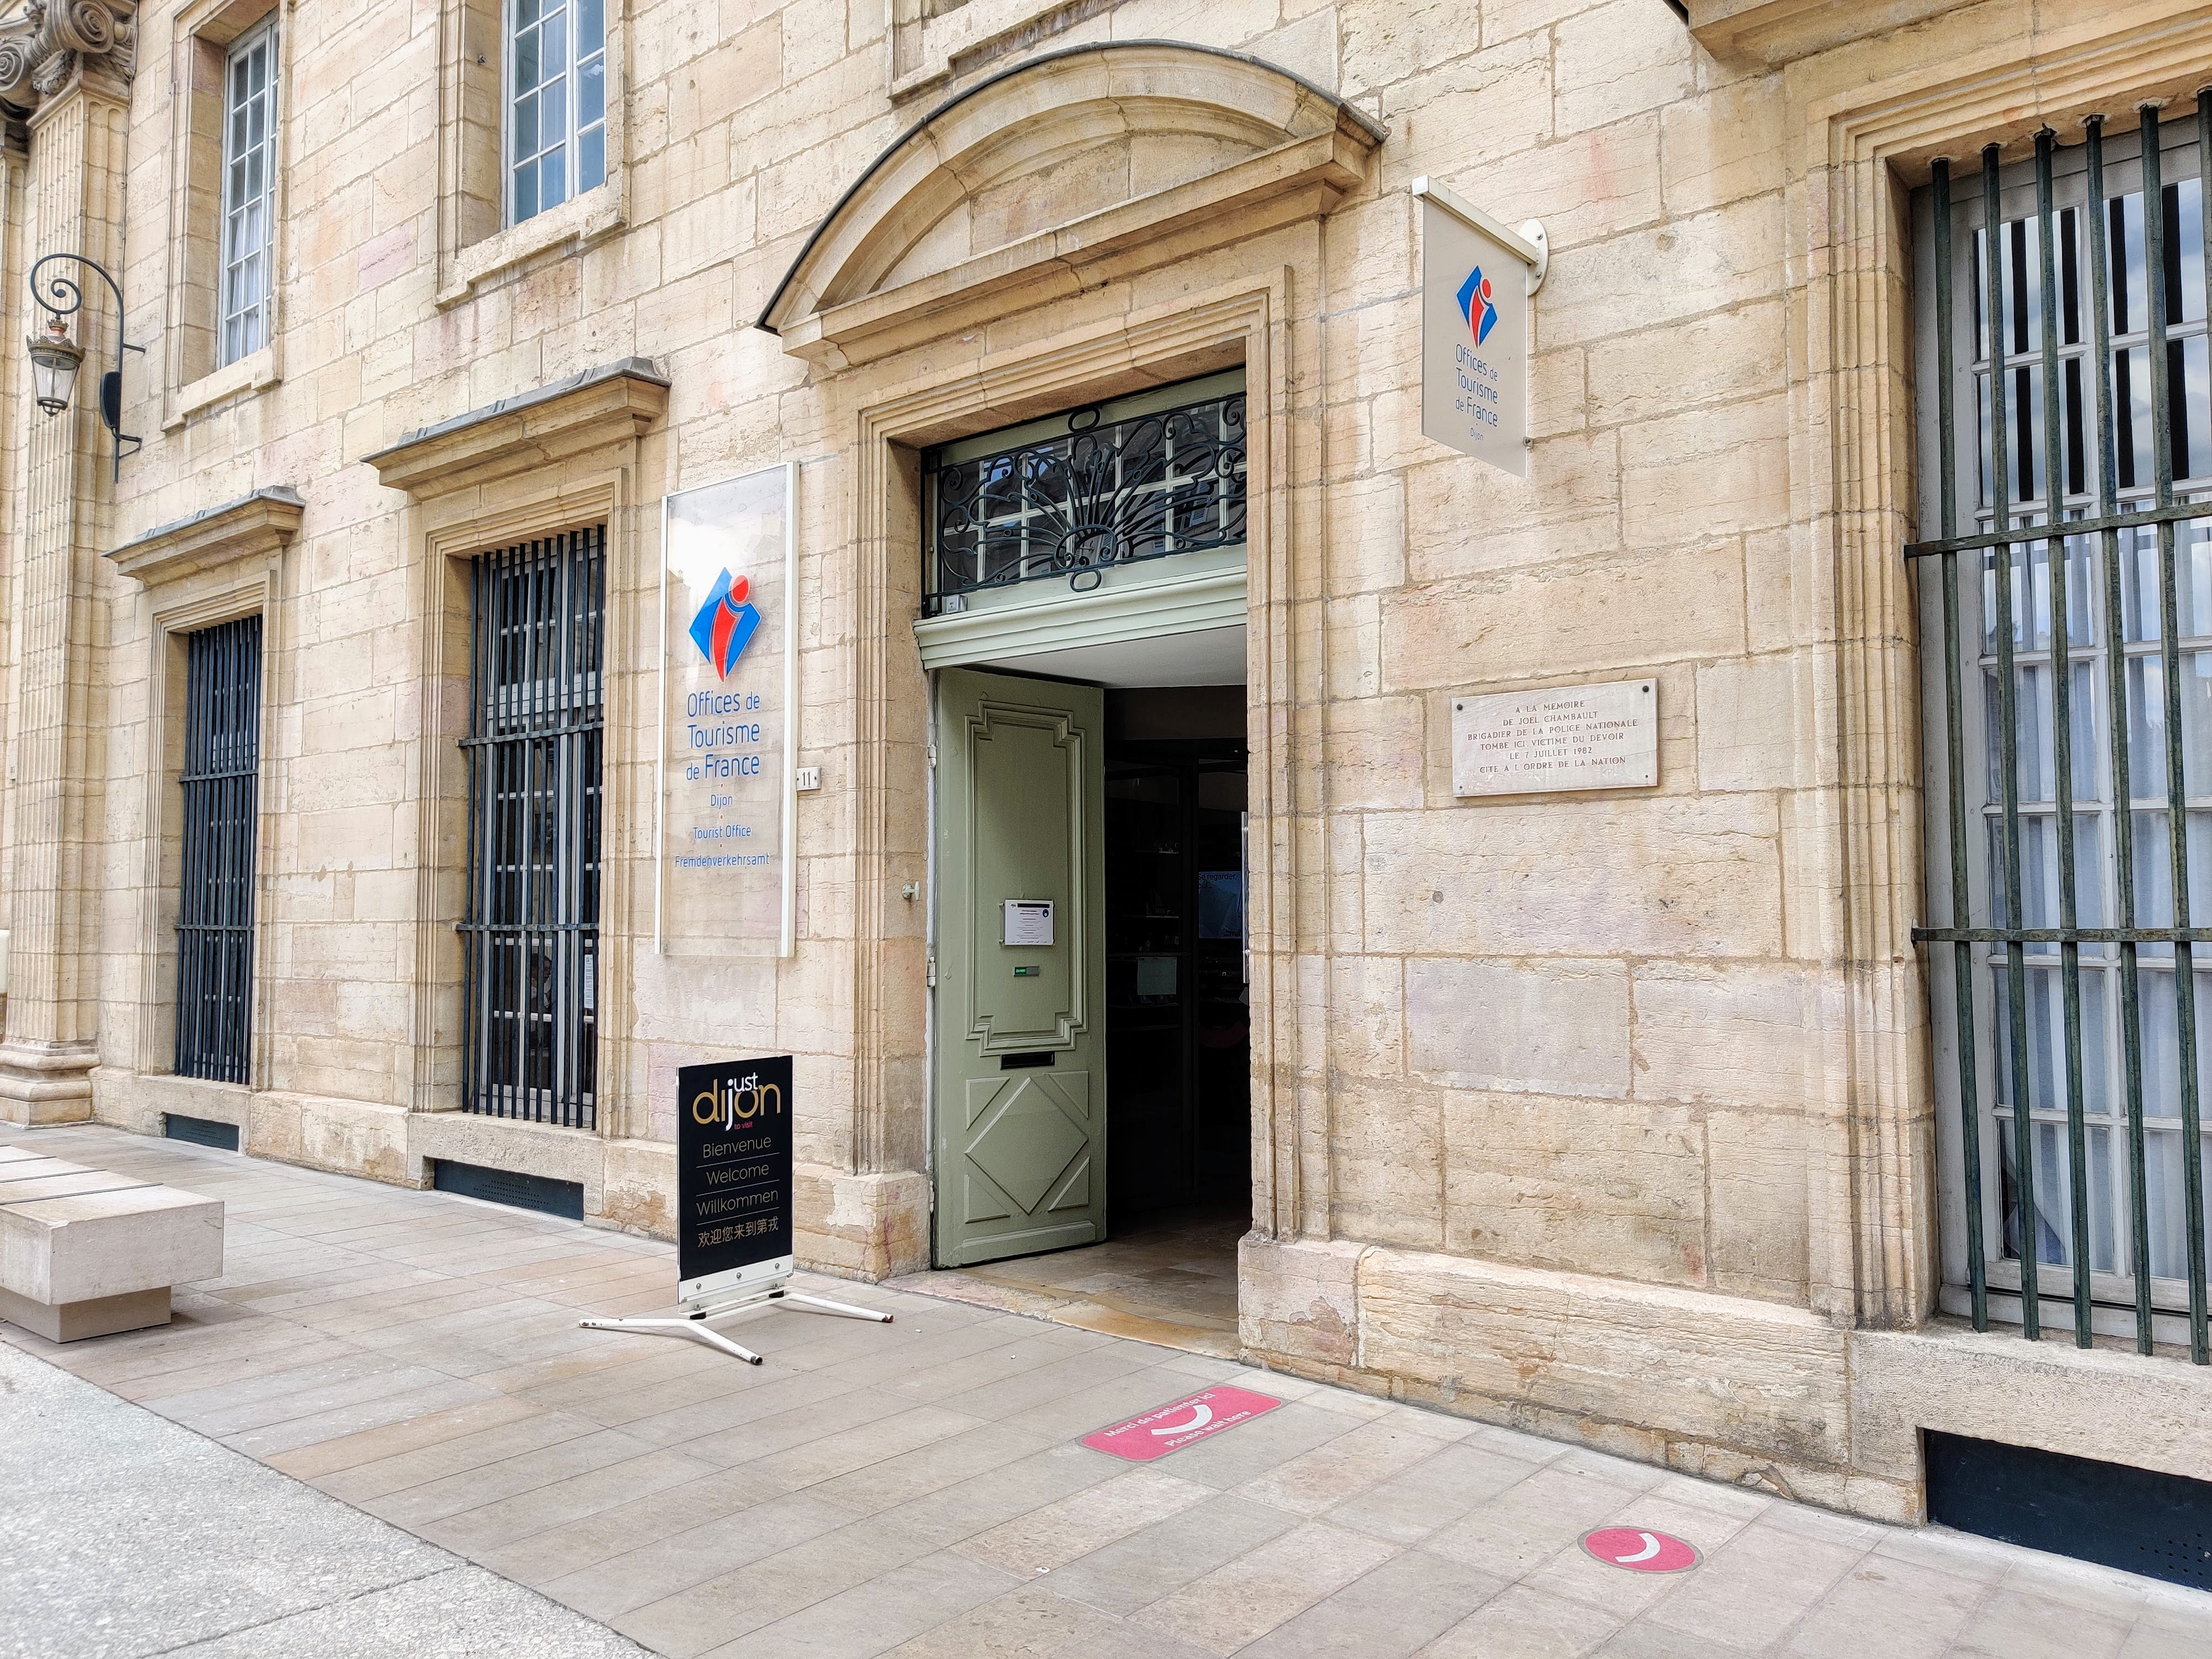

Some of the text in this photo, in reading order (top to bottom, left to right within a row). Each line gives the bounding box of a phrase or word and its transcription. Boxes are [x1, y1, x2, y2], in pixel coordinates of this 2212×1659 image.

[1455, 343, 1498, 382] Offices de
[1455, 367, 1498, 405] Tourisme
[1455, 396, 1498, 427] de France
[1470, 427, 1483, 442] Dijon
[687, 690, 760, 718] Offices de
[1543, 700, 1585, 711] MEMOIRE
[1519, 717, 1540, 725] JOEL
[1544, 711, 1599, 723] CHAMBAULT
[687, 720, 760, 749] Tourisme
[1468, 731, 1511, 740] BRIGADIER
[1550, 724, 1580, 734] POLICE
[1586, 719, 1638, 731] NATIONALE
[1480, 742, 1510, 751] TOMBE
[1531, 737, 1567, 746] VICTIME
[1573, 735, 1584, 743] DU
[1590, 732, 1624, 742] DEVOIR
[1534, 749, 1568, 758] JUILLET
[1574, 747, 1593, 755] 1982
[1592, 757, 1626, 766] NATION
[686, 753, 760, 781] de France
[801, 771, 811, 787] 11
[711, 794, 733, 809] Dijon
[692, 824, 752, 839] Tourist Office
[675, 852, 770, 868] Fremdenverkehrsamt
[1207, 873, 1237, 881] regarder,
[692, 1078, 781, 1131] dijon
[703, 1136, 771, 1159] Bienvenue
[706, 1164, 769, 1185] Welcome
[696, 1190, 778, 1216] Willkommen
[697, 1215, 779, 1248] 欢迎您来到第戎
[1103, 1422, 1139, 1437] Merci
[1151, 1395, 1203, 1419] patienter
[1164, 1411, 1251, 1447] Please wait here
